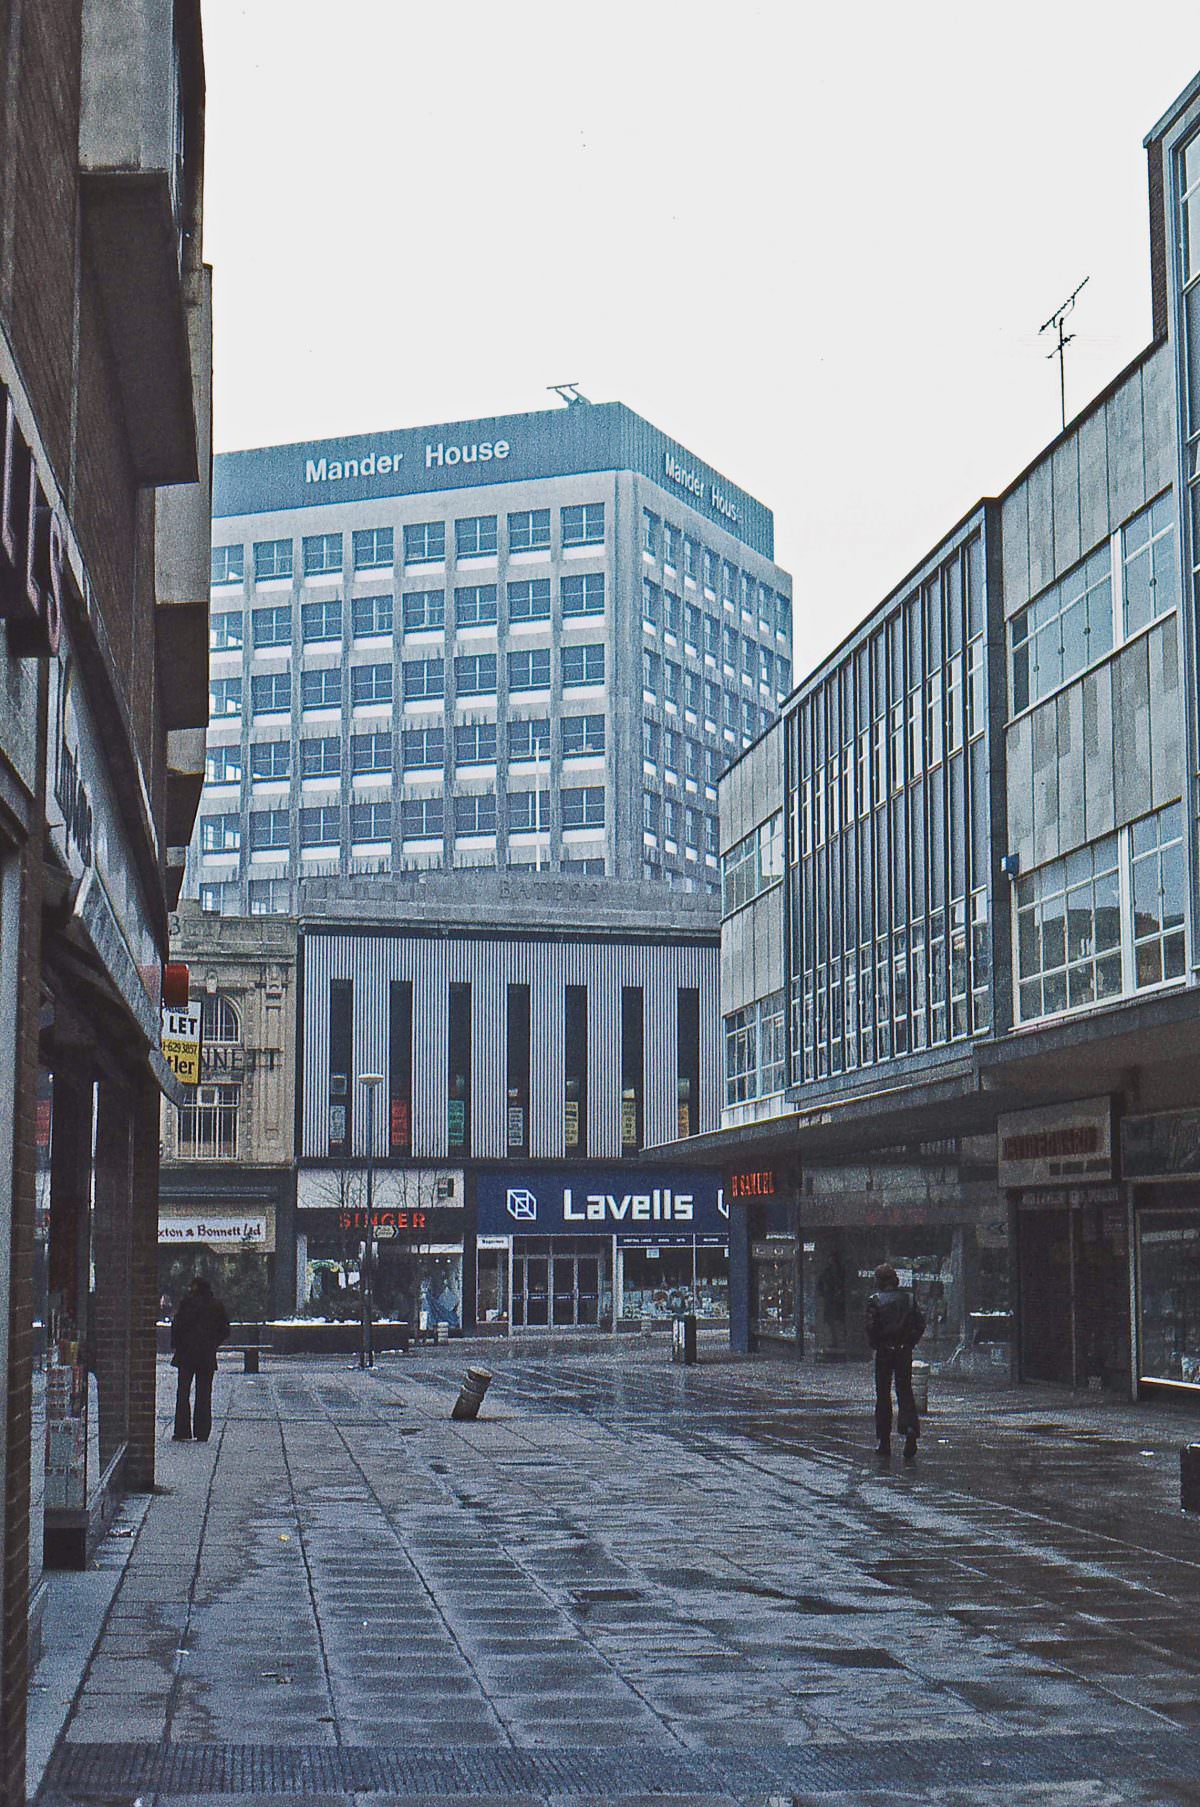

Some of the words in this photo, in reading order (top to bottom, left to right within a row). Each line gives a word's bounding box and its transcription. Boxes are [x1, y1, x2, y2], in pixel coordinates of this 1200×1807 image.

[305, 452, 403, 483] Mander
[425, 439, 510, 468] House
[665, 452, 705, 498] Mander
[711, 485, 743, 523] Hous
[169, 1015, 198, 1035] LET
[740, 1171, 775, 1196] SAMUEL
[563, 1189, 694, 1221] Lavells
[197, 1224, 241, 1238] Bonnett
[340, 1212, 426, 1228] SINGER
